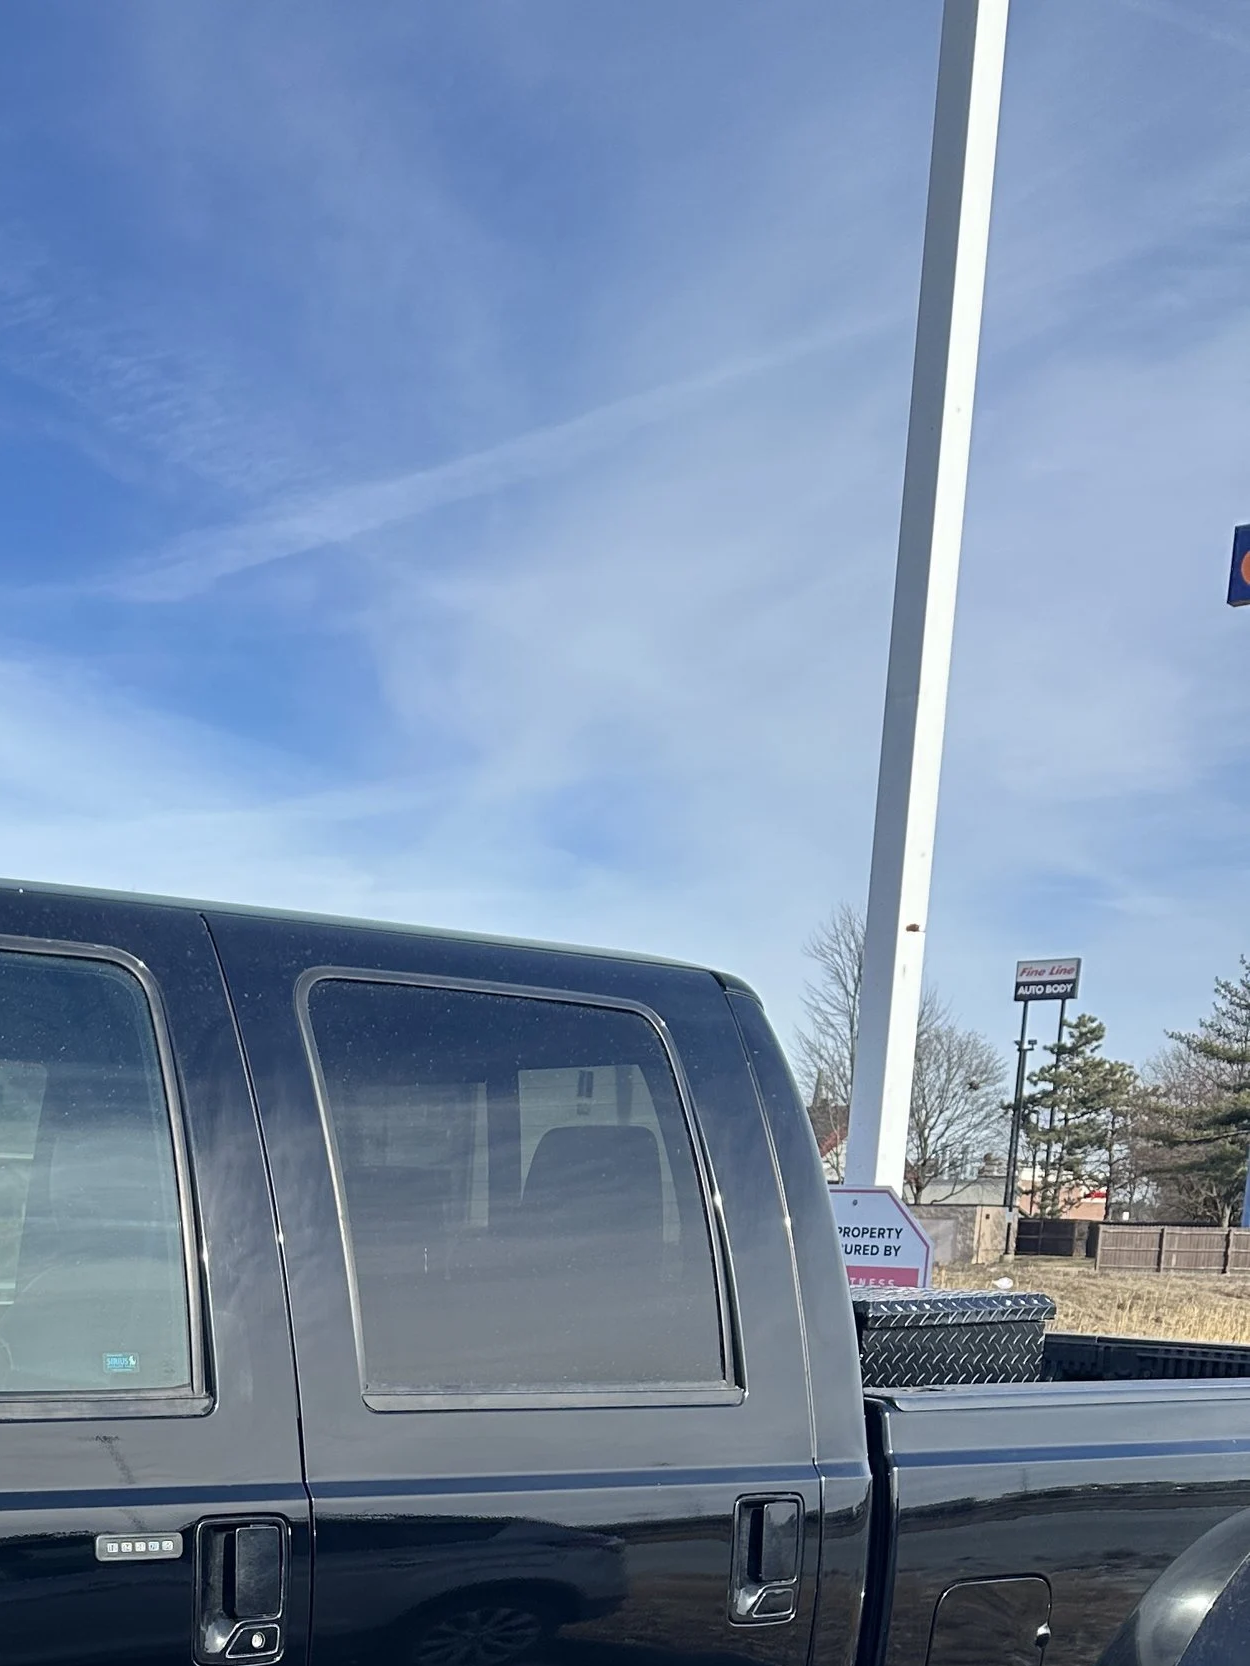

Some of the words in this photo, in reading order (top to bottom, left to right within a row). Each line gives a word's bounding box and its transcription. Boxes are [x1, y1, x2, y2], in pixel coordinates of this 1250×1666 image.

[1019, 966, 1046, 977] Fine
[1049, 964, 1075, 976] Line
[1017, 985, 1044, 995] AUTO
[1045, 983, 1073, 994] BODY
[841, 1243, 880, 1256] URED
[883, 1244, 902, 1257] BY
